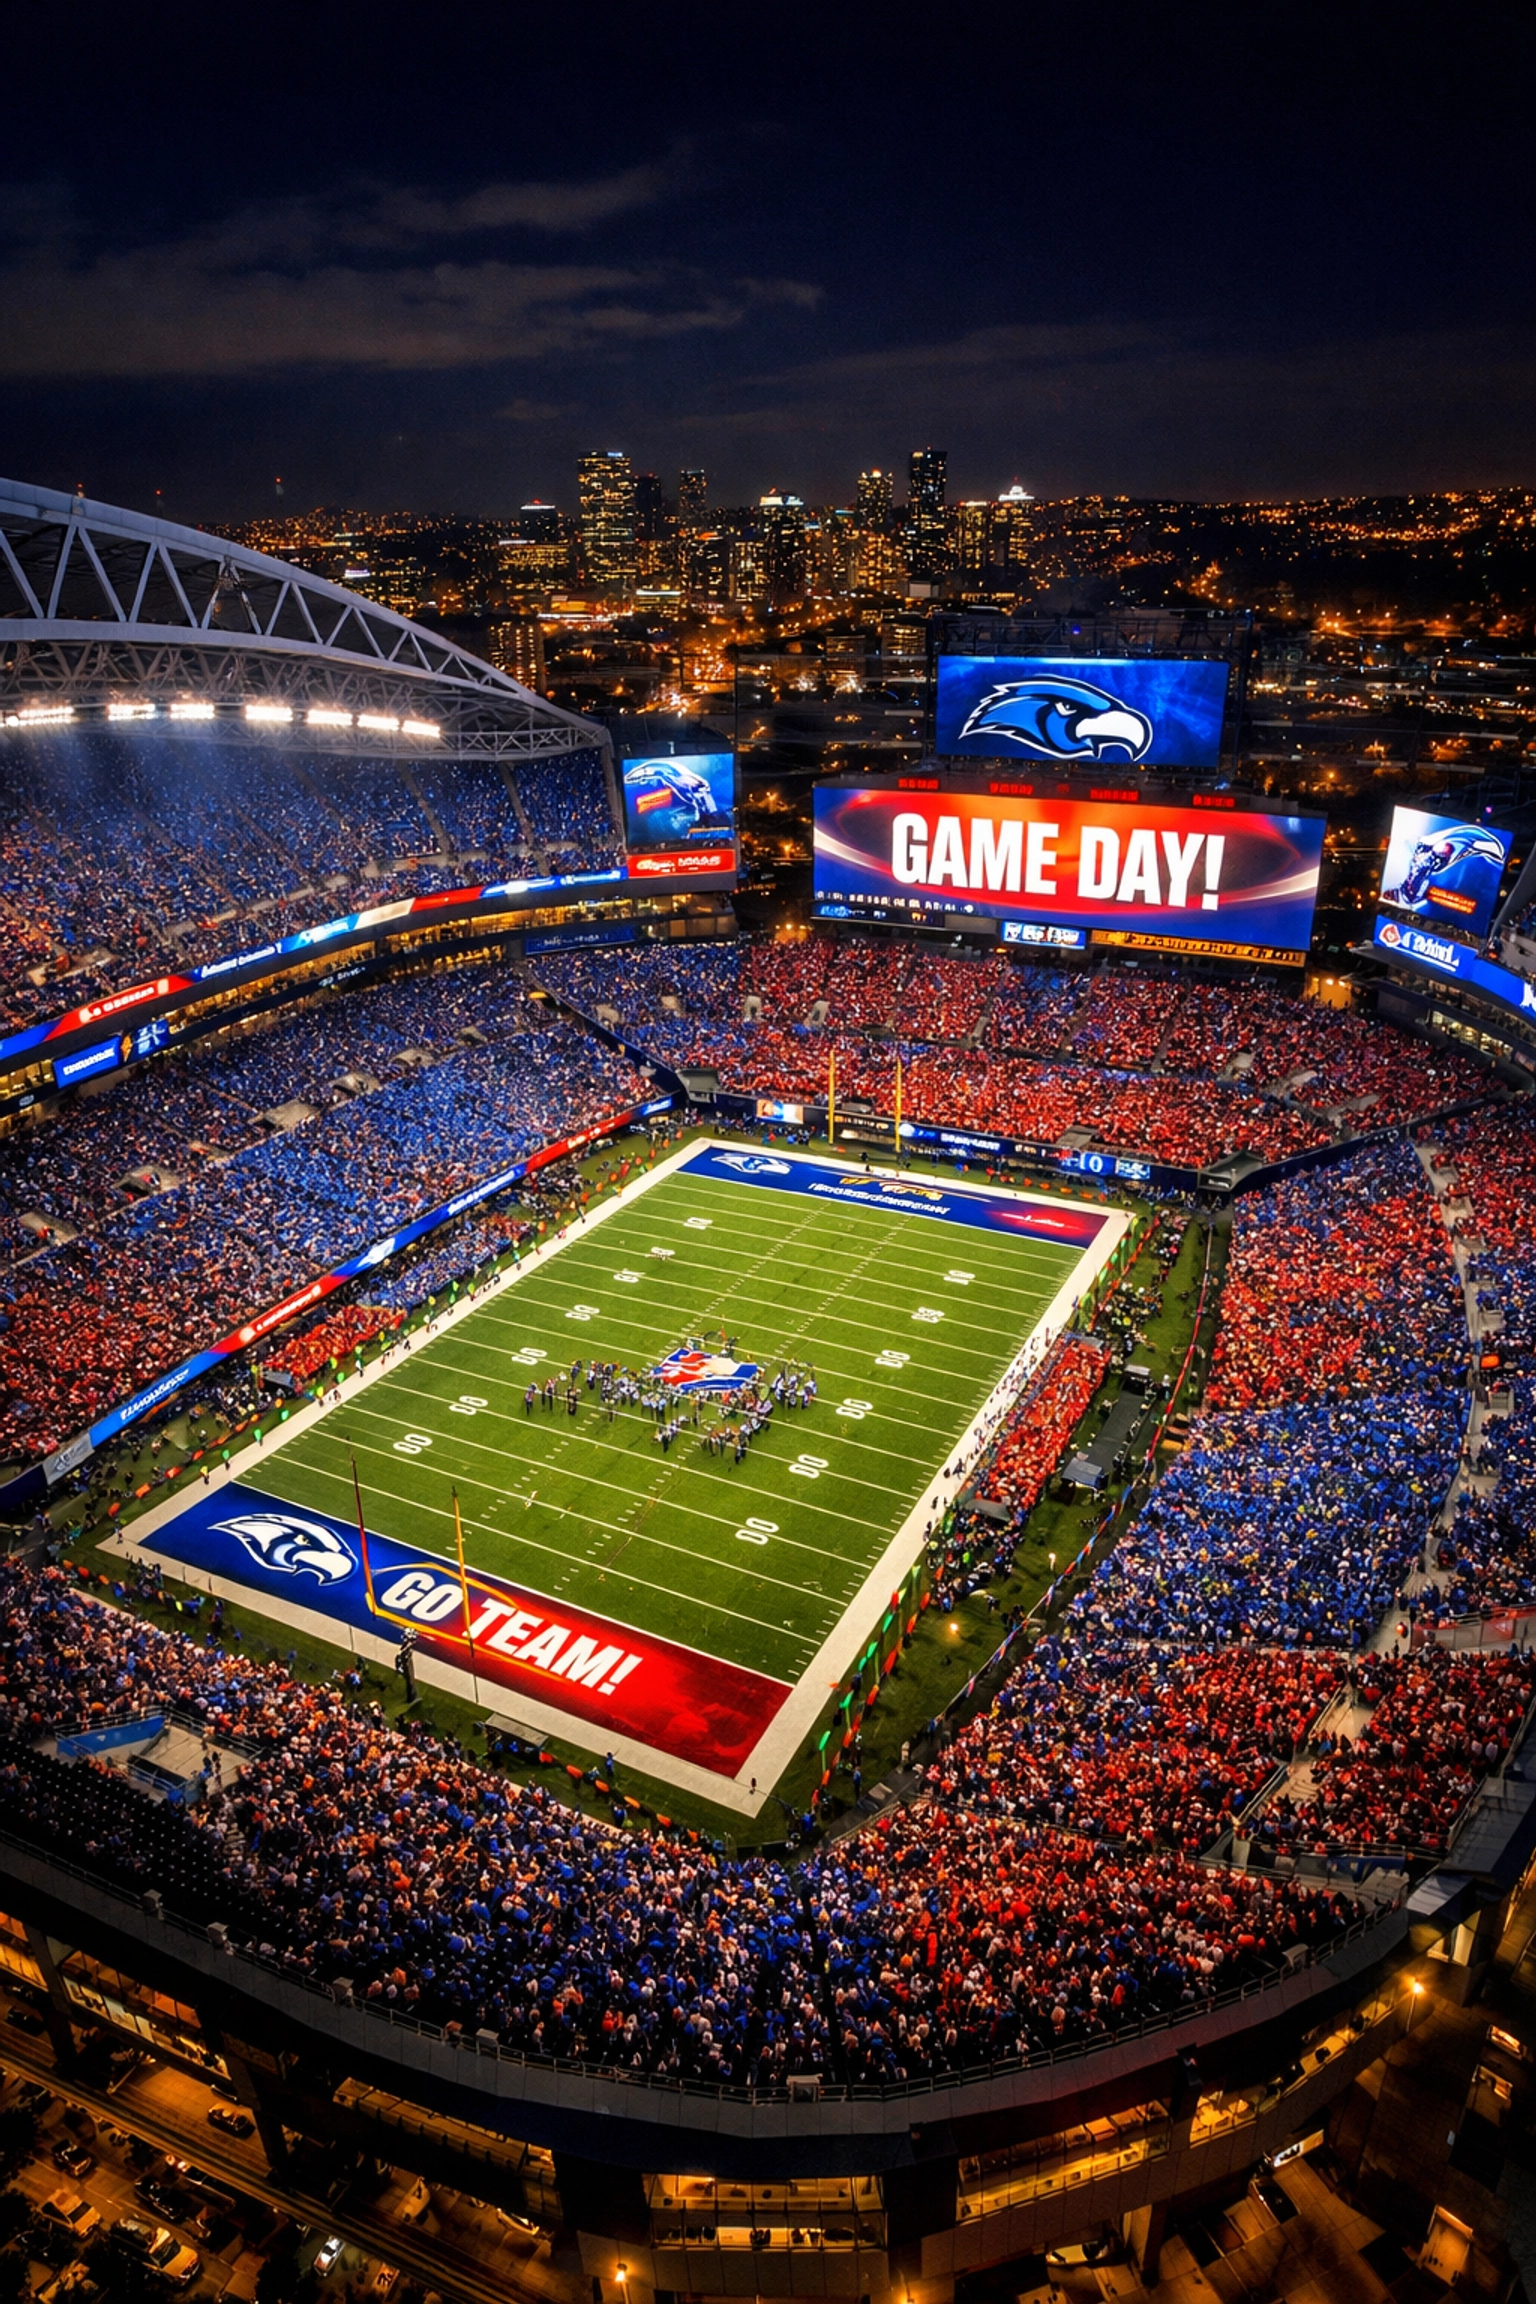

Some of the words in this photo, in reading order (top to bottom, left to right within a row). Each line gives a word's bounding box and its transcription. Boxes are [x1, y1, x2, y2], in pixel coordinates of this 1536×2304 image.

[892, 813, 1059, 894] GAME
[1077, 825, 1225, 911] DAY!
[381, 1572, 464, 1621] GO
[462, 1598, 644, 1696] TEAM!
